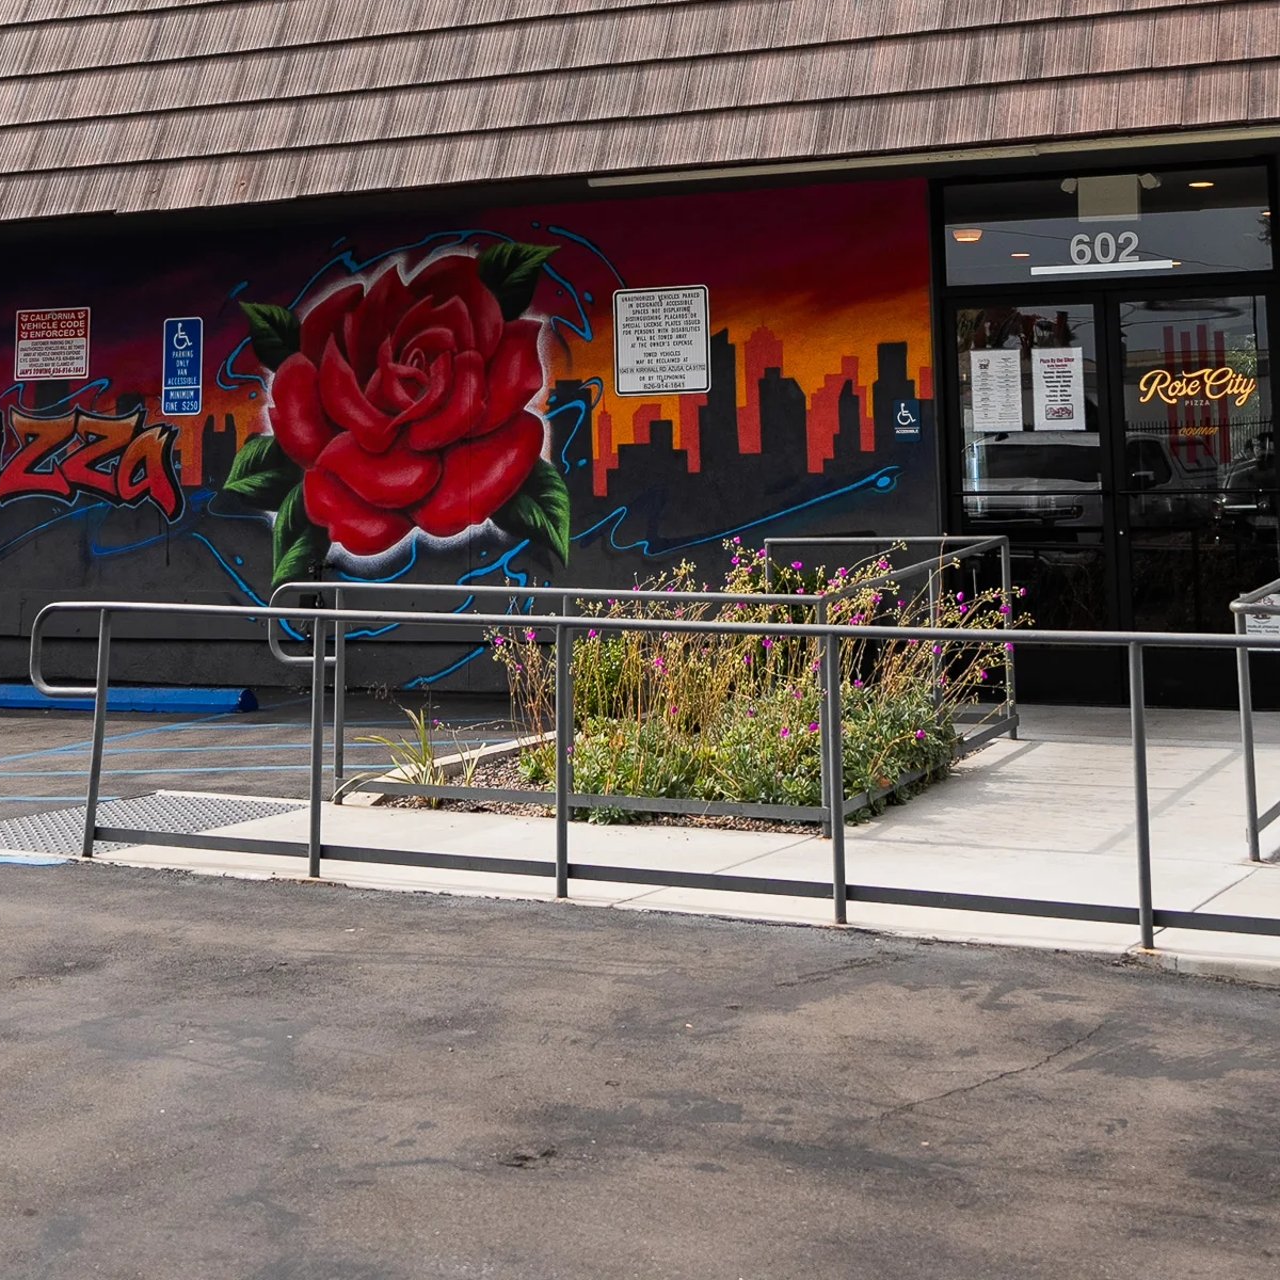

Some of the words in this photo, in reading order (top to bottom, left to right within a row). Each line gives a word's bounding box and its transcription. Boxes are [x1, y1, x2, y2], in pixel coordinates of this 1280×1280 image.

[1070, 231, 1140, 264] 602
[30, 312, 76, 321] CALIFORNIA
[21, 321, 58, 330] VEHICLE
[60, 320, 85, 328] CODE
[30, 329, 75, 338] ENFORCED
[167, 376, 197, 385] ACCESSIBLE
[1139, 369, 1201, 404] Rose
[1183, 367, 1256, 406] City
[170, 391, 194, 399] MINIMUM
[165, 402, 177, 411] FINE
[182, 401, 198, 410] $250
